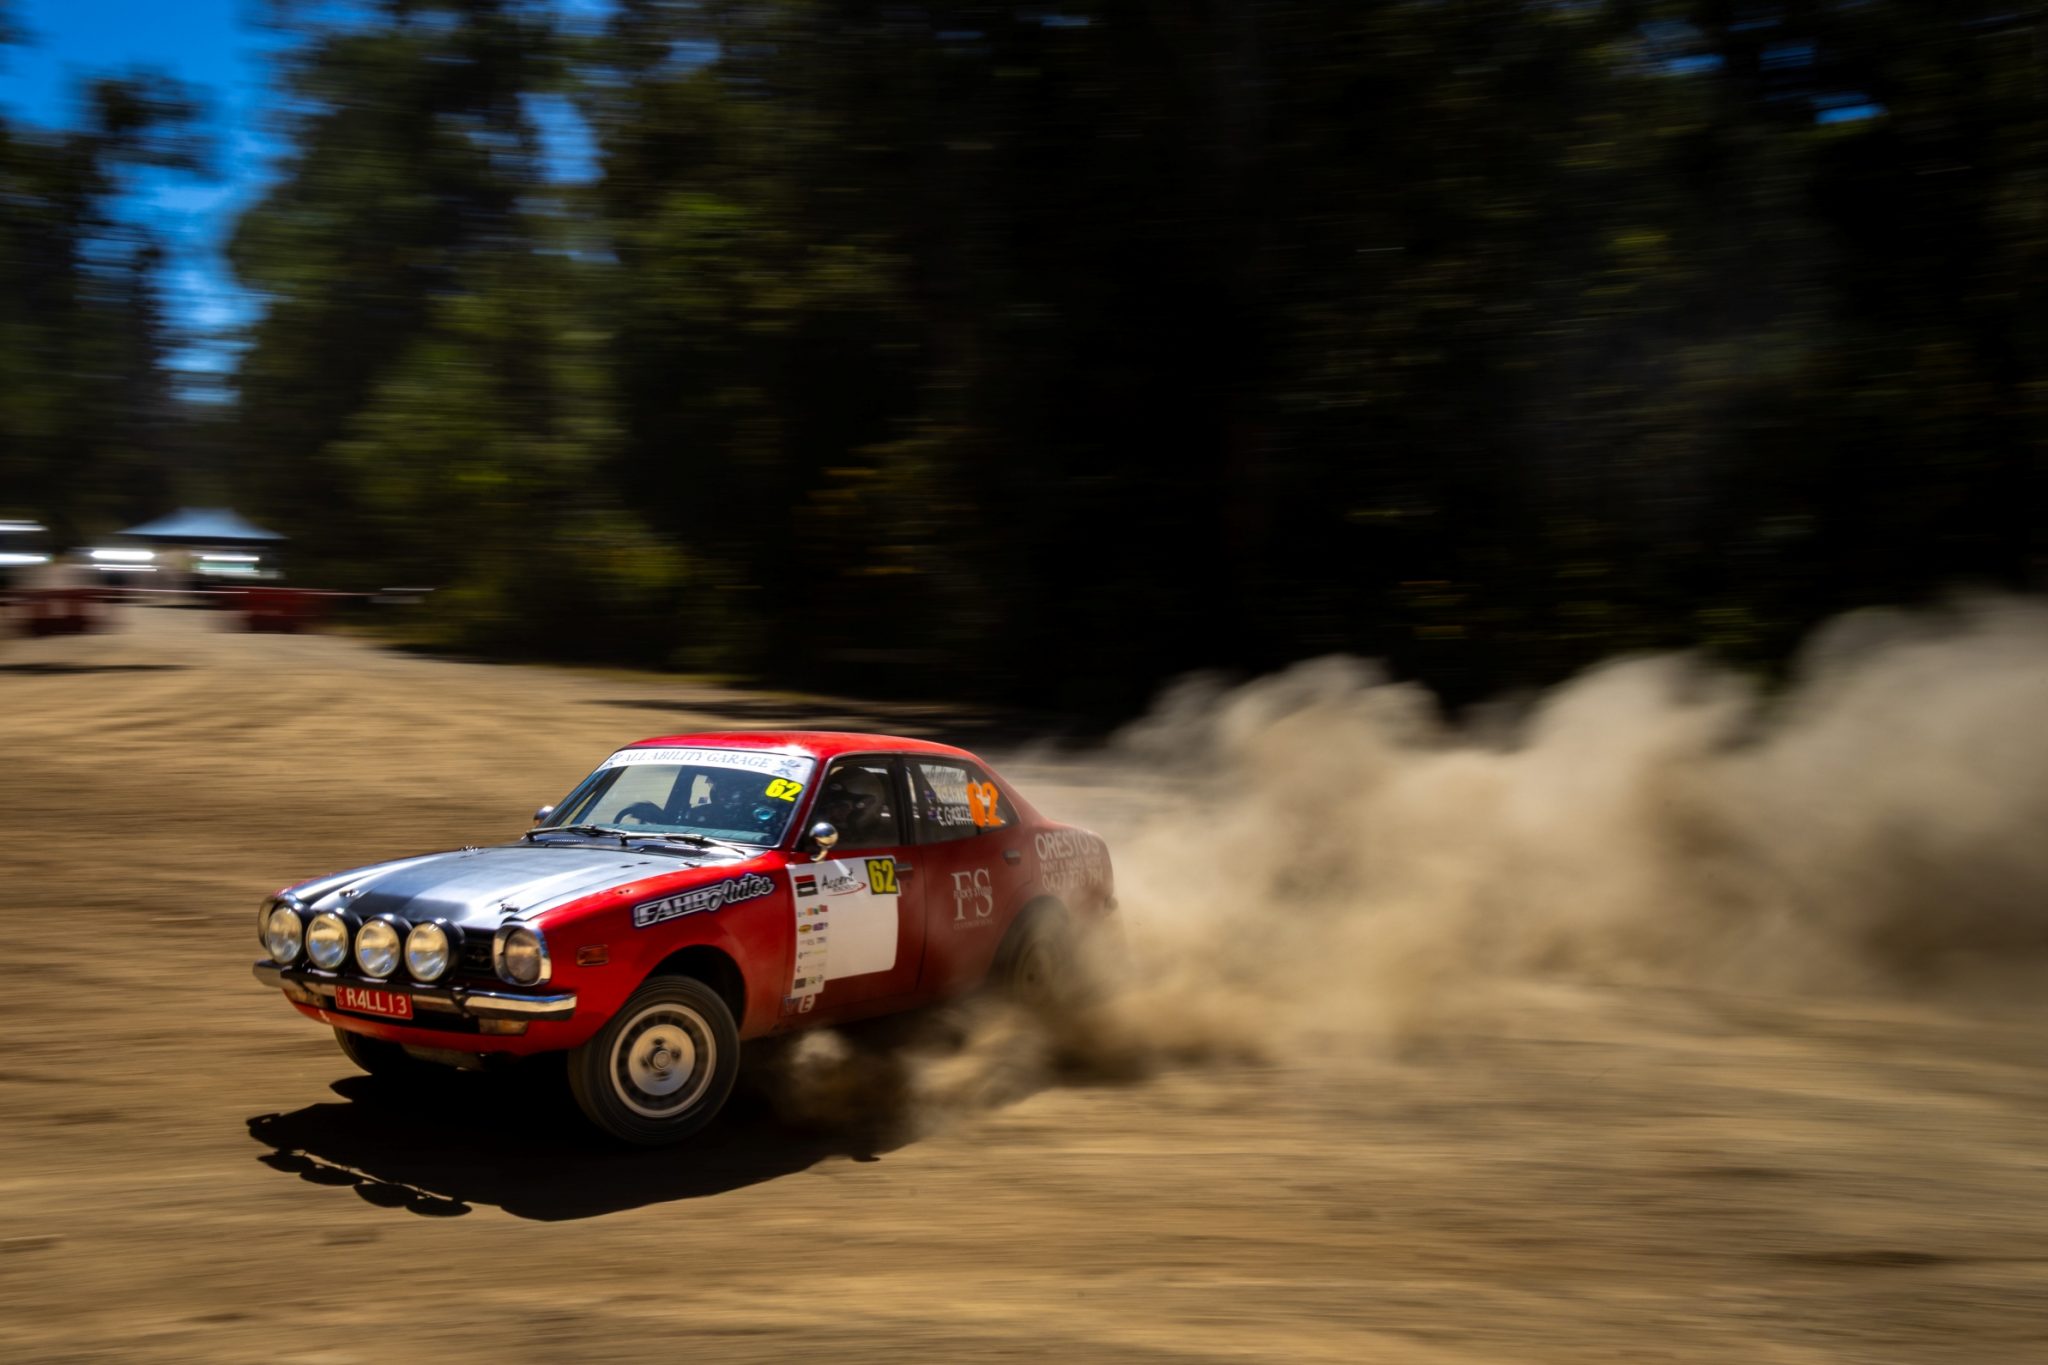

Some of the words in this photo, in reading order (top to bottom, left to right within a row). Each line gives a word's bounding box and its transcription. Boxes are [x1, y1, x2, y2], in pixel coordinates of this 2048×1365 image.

[621, 753, 648, 763] ALL
[650, 750, 706, 762] ABILITY
[706, 751, 773, 769] GARAGE
[765, 778, 804, 803] 62
[966, 781, 1004, 828] 62
[706, 872, 774, 911] Autos
[867, 859, 898, 894] 62
[950, 867, 994, 921] FS
